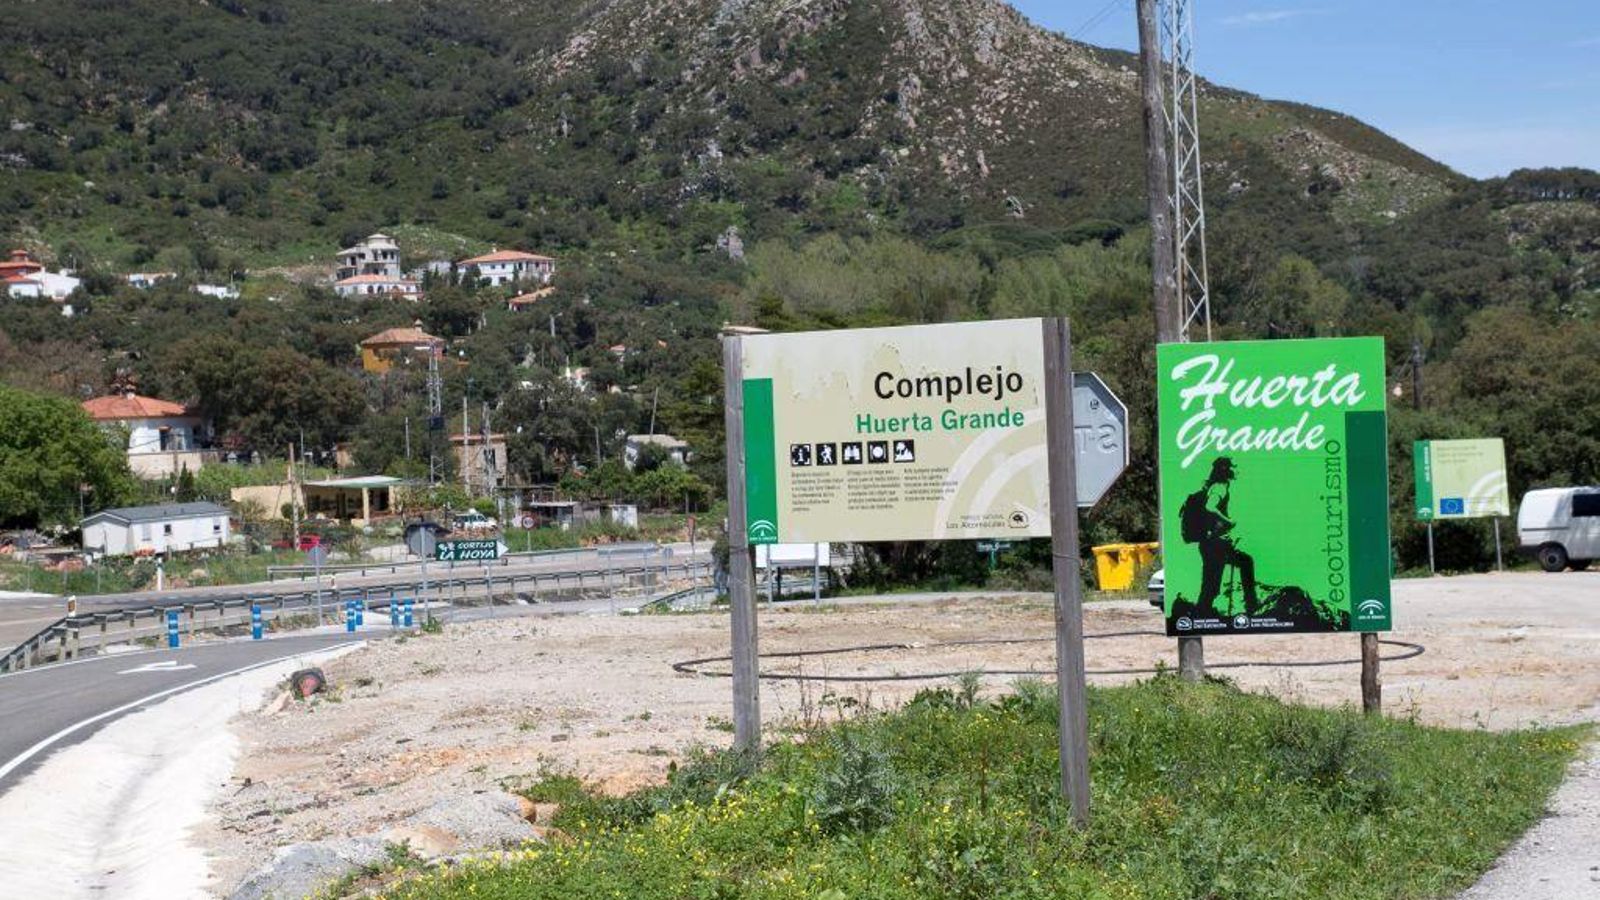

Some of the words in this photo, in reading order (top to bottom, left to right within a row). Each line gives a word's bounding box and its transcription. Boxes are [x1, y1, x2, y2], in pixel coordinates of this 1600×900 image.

[874, 365, 1023, 404] Complejo
[1172, 354, 1364, 409] Huerta
[856, 412, 933, 434] Huerta
[941, 407, 1025, 431] Grande
[1176, 409, 1326, 469] Grande
[1322, 439, 1345, 603] ecoturismo
[439, 551, 455, 560] LA
[460, 549, 495, 559] HOYA
[457, 541, 495, 549] CORTIJO
